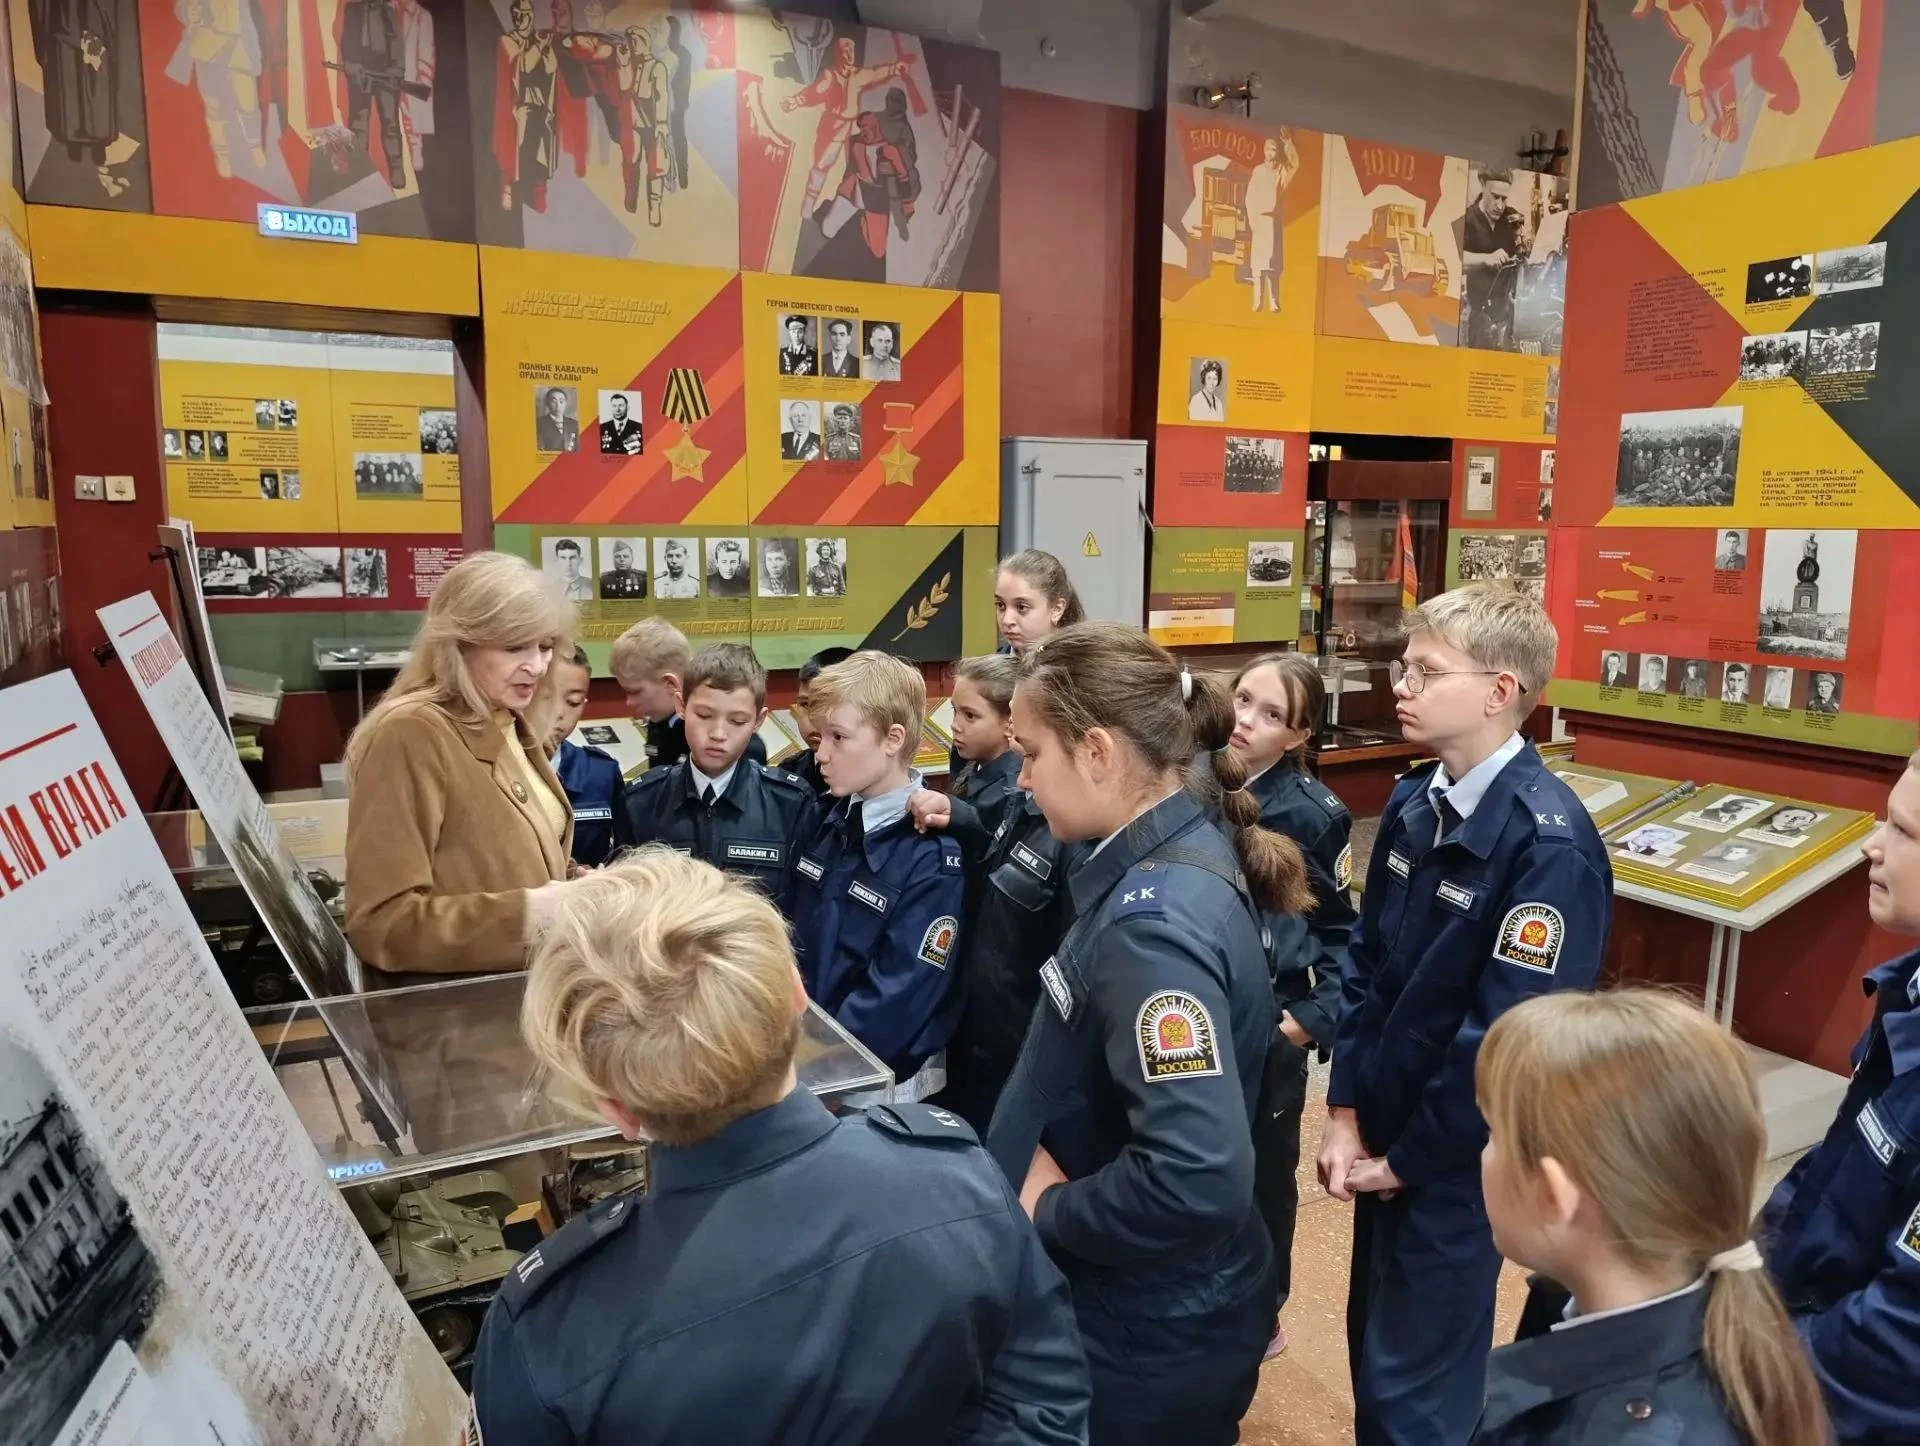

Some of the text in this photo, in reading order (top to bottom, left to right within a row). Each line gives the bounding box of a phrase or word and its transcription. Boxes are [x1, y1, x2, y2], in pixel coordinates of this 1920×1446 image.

[1361, 147, 1416, 181] 1000
[267, 210, 348, 237] ВЫХОД
[766, 299, 860, 314] ГЕРОИ СОВЕТСКОГО СОЮЗА
[519, 362, 599, 376] ПОЛНЫЕ КАВАЛЕРЫ
[519, 371, 582, 382] ОРДЕНА СЛАВЫ
[29, 761, 127, 859] ВРАГА
[729, 848, 778, 858] БАЛАКИН А.
[1506, 948, 1549, 967] РОССИИ
[1156, 1059, 1208, 1074] РОССИИ
